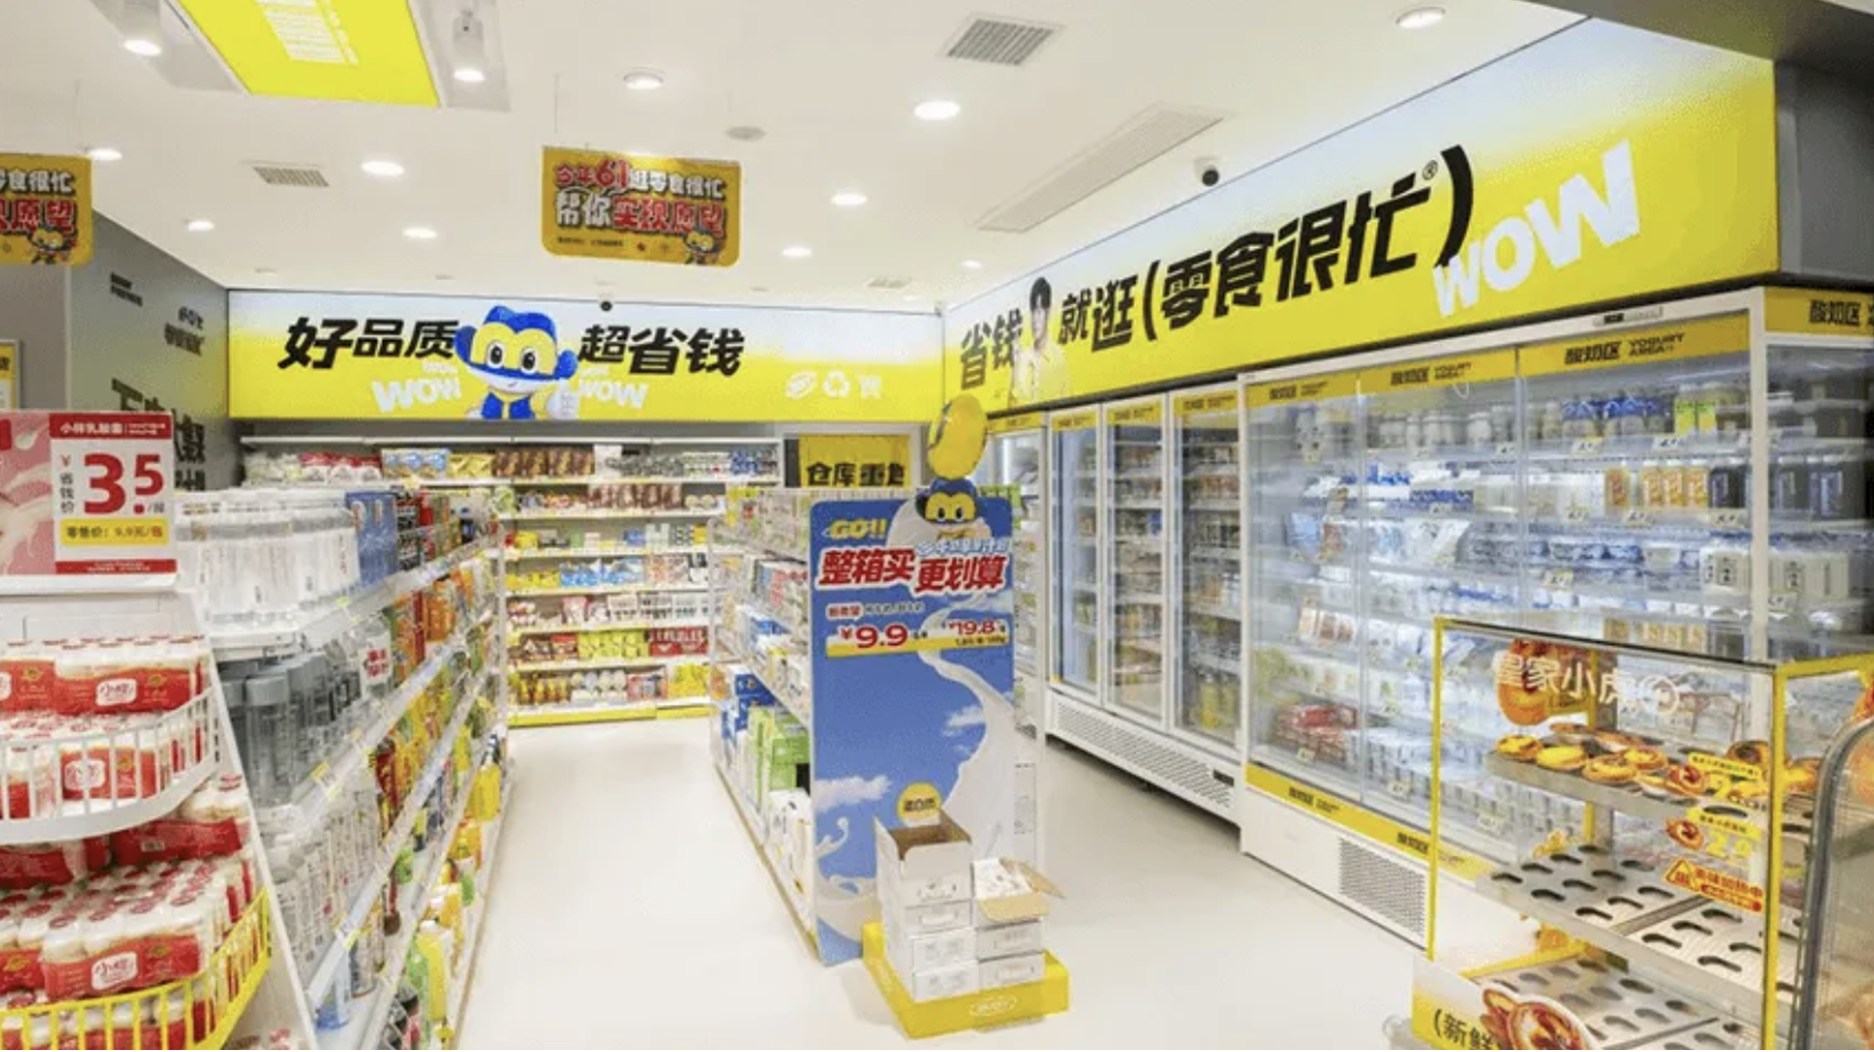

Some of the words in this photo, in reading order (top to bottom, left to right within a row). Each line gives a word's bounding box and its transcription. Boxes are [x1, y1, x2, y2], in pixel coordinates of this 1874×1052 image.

[1432, 137, 1641, 318] WOW
[277, 316, 460, 369] 好品质
[575, 324, 746, 377] 超省钱
[960, 307, 1024, 391] 省钱
[370, 377, 462, 413] WOW
[817, 549, 916, 586] 整箱买
[914, 555, 1007, 593] 更划算
